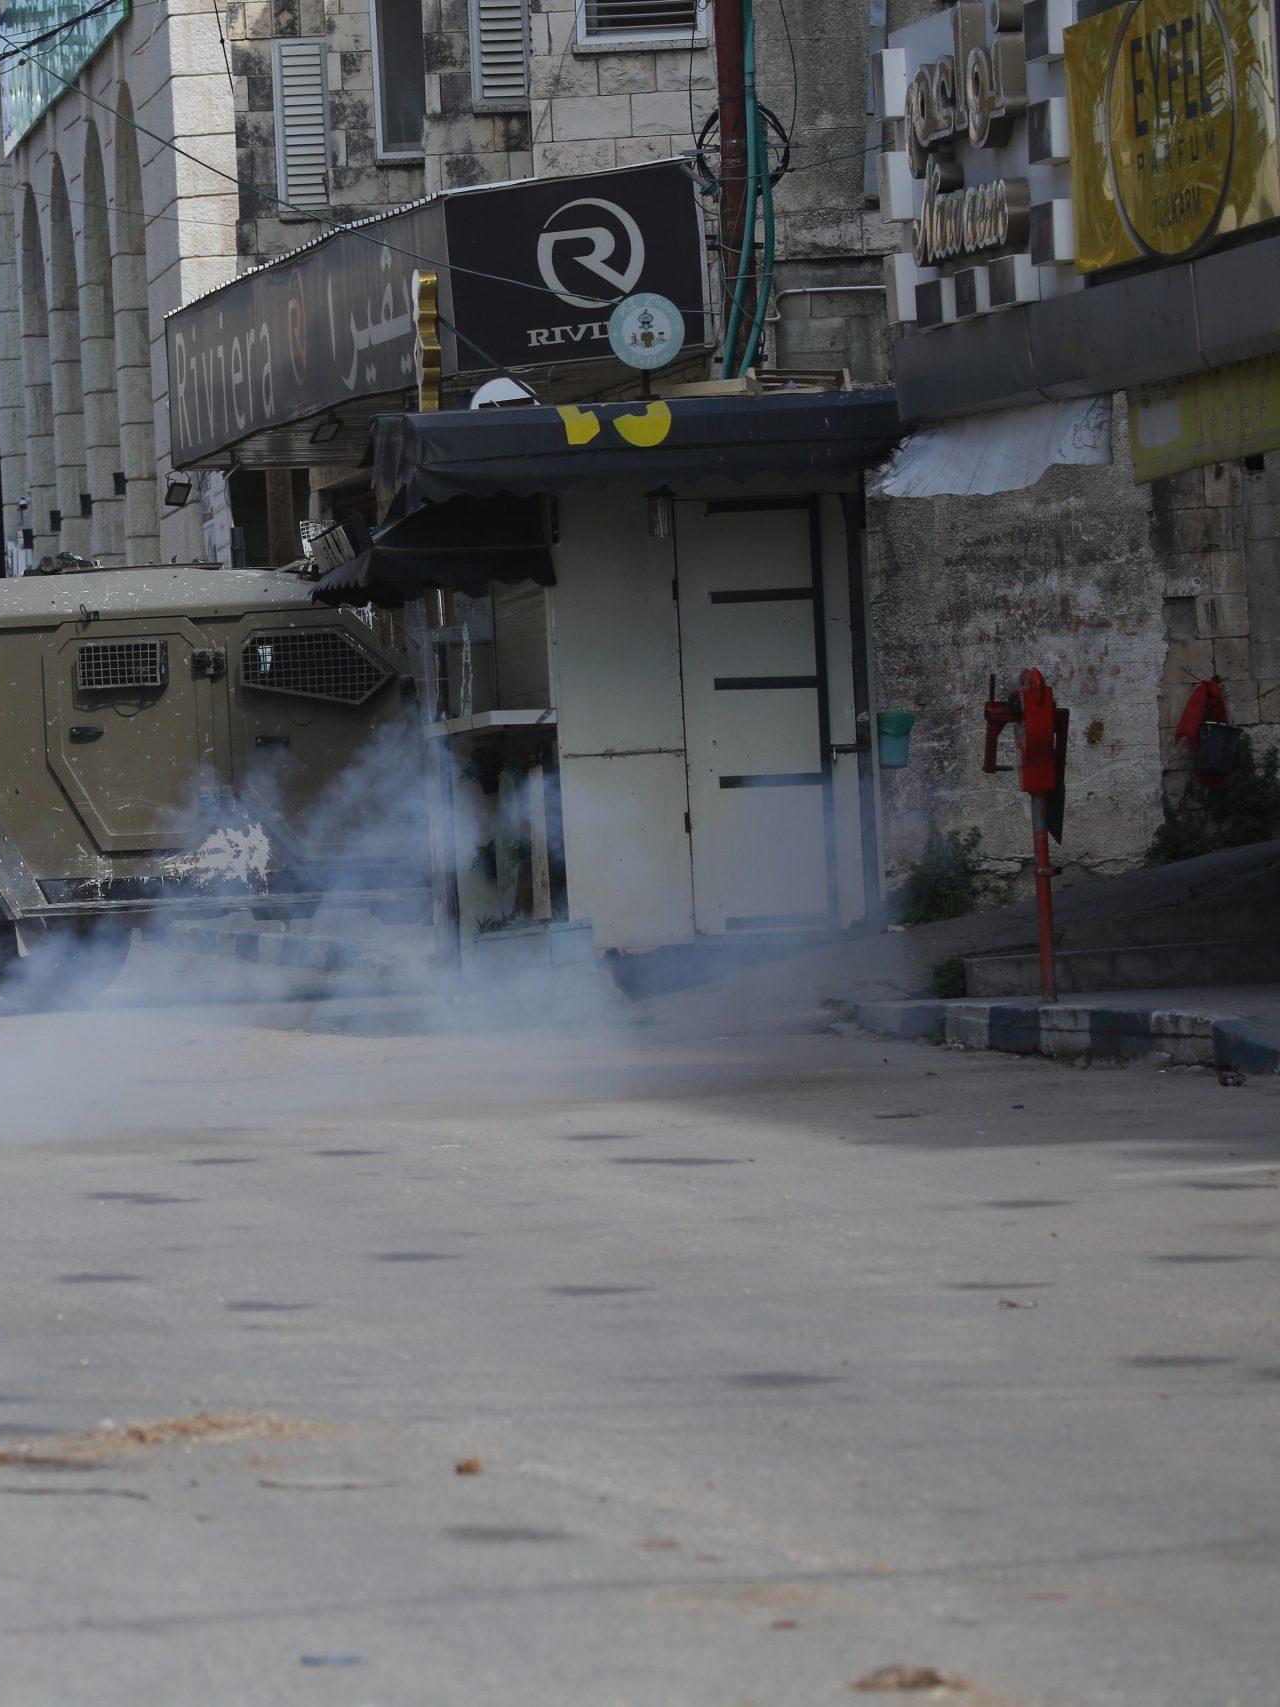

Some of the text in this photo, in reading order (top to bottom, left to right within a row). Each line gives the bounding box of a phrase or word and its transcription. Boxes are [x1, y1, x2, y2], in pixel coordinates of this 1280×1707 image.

[1130, 12, 1213, 137] EYFEL
[1137, 129, 1216, 180] PARFUM
[526, 320, 611, 347] RIVI
[175, 311, 276, 450] Riviera
